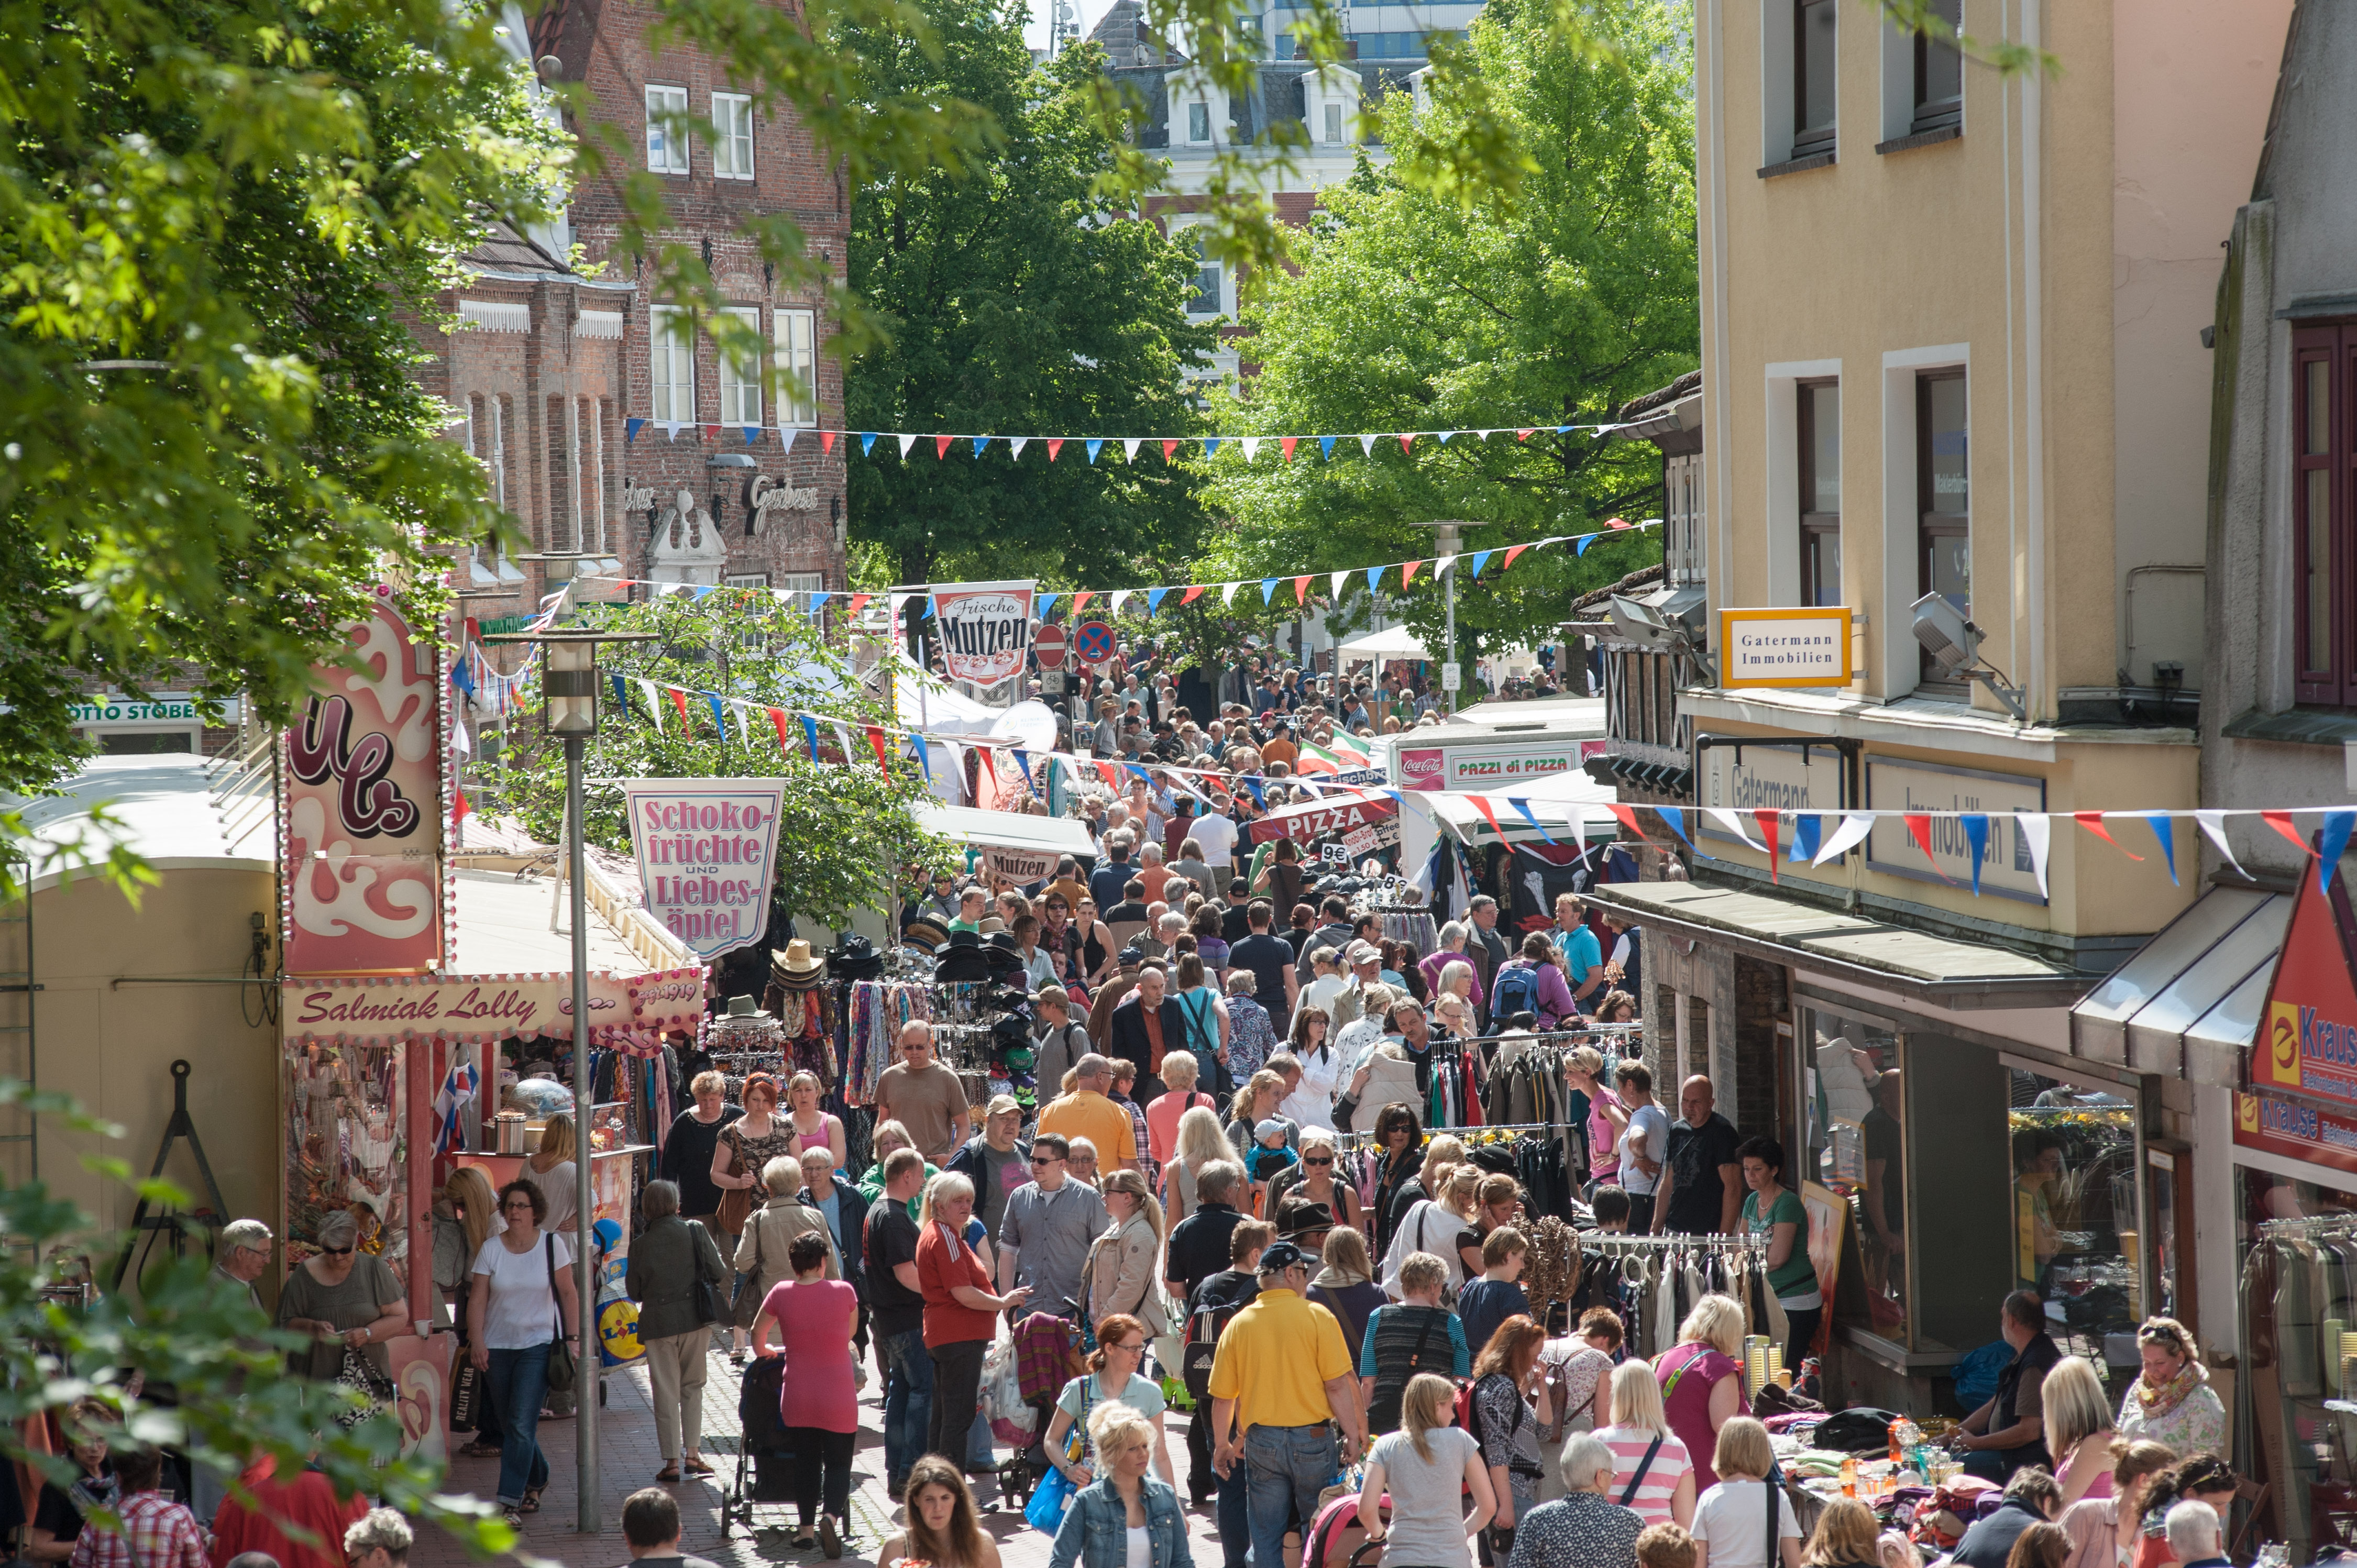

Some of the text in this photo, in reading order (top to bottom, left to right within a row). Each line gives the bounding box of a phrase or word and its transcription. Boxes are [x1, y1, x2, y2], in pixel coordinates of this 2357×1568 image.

[953, 598, 1018, 617] Frische
[939, 614, 1027, 656] Mutzen
[1742, 635, 1832, 646] Gatermann
[1743, 652, 1832, 664] Immobilien
[70, 704, 199, 721] OTTO STÖBE
[1459, 757, 1567, 776] PAZZI di PIZZA
[645, 801, 775, 831] Schoko-
[1286, 807, 1366, 836] PIZZA
[1907, 787, 2002, 864] Imobien
[1343, 827, 1374, 846] Knobi-Brot
[1374, 822, 1400, 836] affee
[648, 834, 761, 865] früchte
[1323, 845, 1346, 861] 9€
[1357, 843, 1370, 853] 1,50
[993, 855, 1047, 877] Mutzen
[655, 876, 762, 906] Liebes-
[667, 908, 740, 943] äpfel
[296, 987, 537, 1027] Salmiak Lolly
[2262, 1099, 2318, 1139] Krause
[455, 1367, 475, 1421] REALITY WEAR
